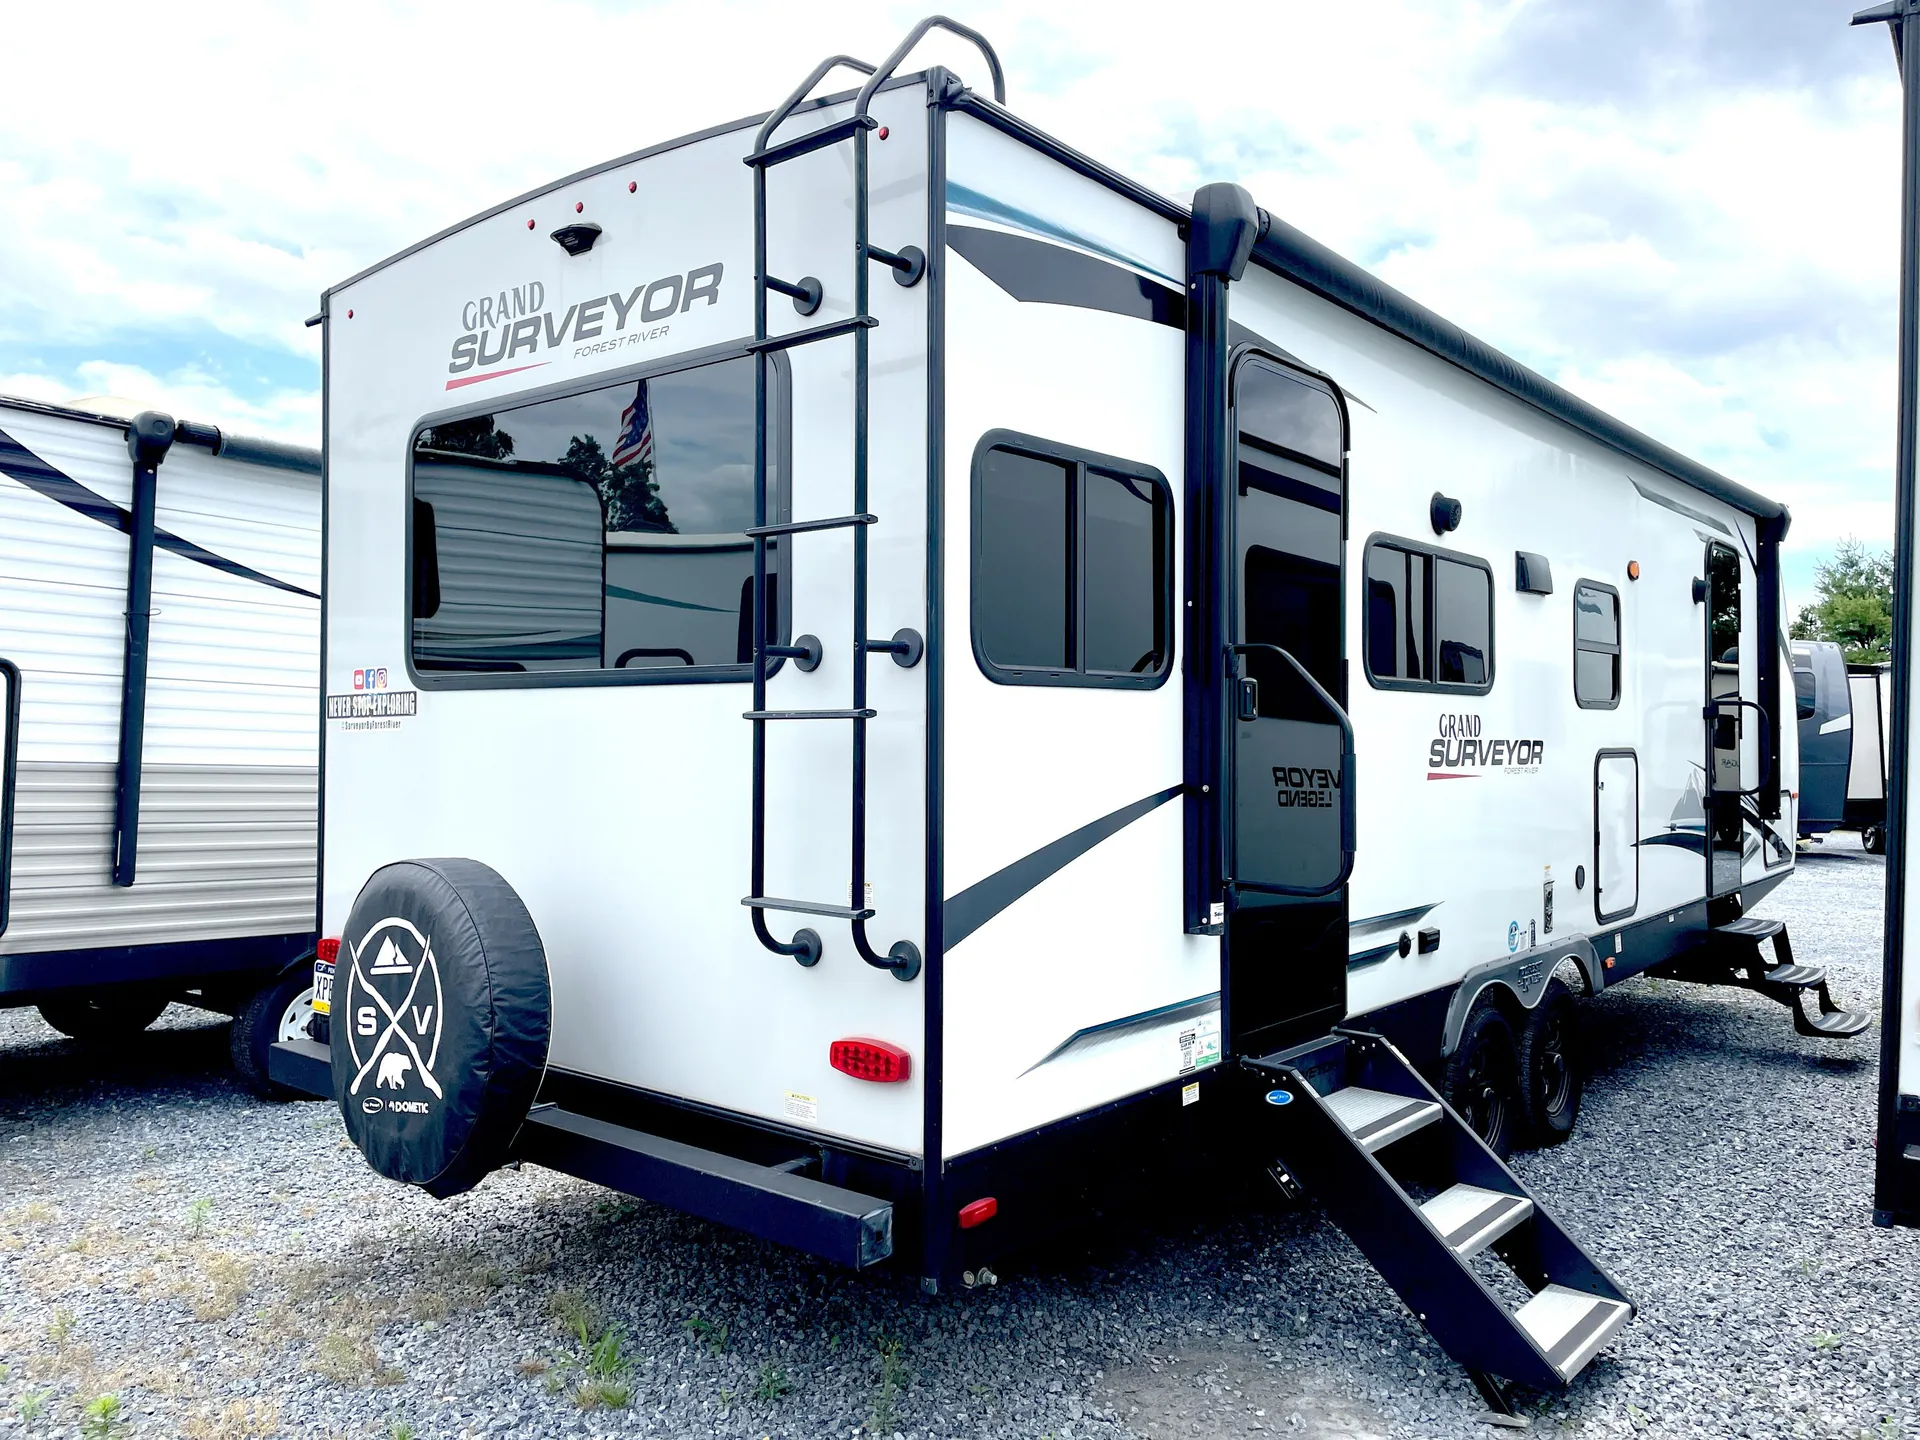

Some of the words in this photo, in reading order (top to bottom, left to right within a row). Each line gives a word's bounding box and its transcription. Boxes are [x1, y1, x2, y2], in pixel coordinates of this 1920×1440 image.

[449, 262, 724, 374] SURVEYOR
[462, 281, 545, 332] GRAND
[573, 337, 627, 359] FOREST
[627, 325, 670, 347] RIVER
[328, 696, 351, 717] NEVER
[352, 695, 371, 716] STOP
[372, 692, 415, 716] EXPLORING
[1438, 713, 1481, 741] GRAND
[1429, 739, 1544, 767] SURVEYOR
[1503, 767, 1524, 775] FOREST
[357, 1006, 377, 1036] S
[411, 1005, 434, 1035] V
[395, 1100, 429, 1114] DOMETIC
